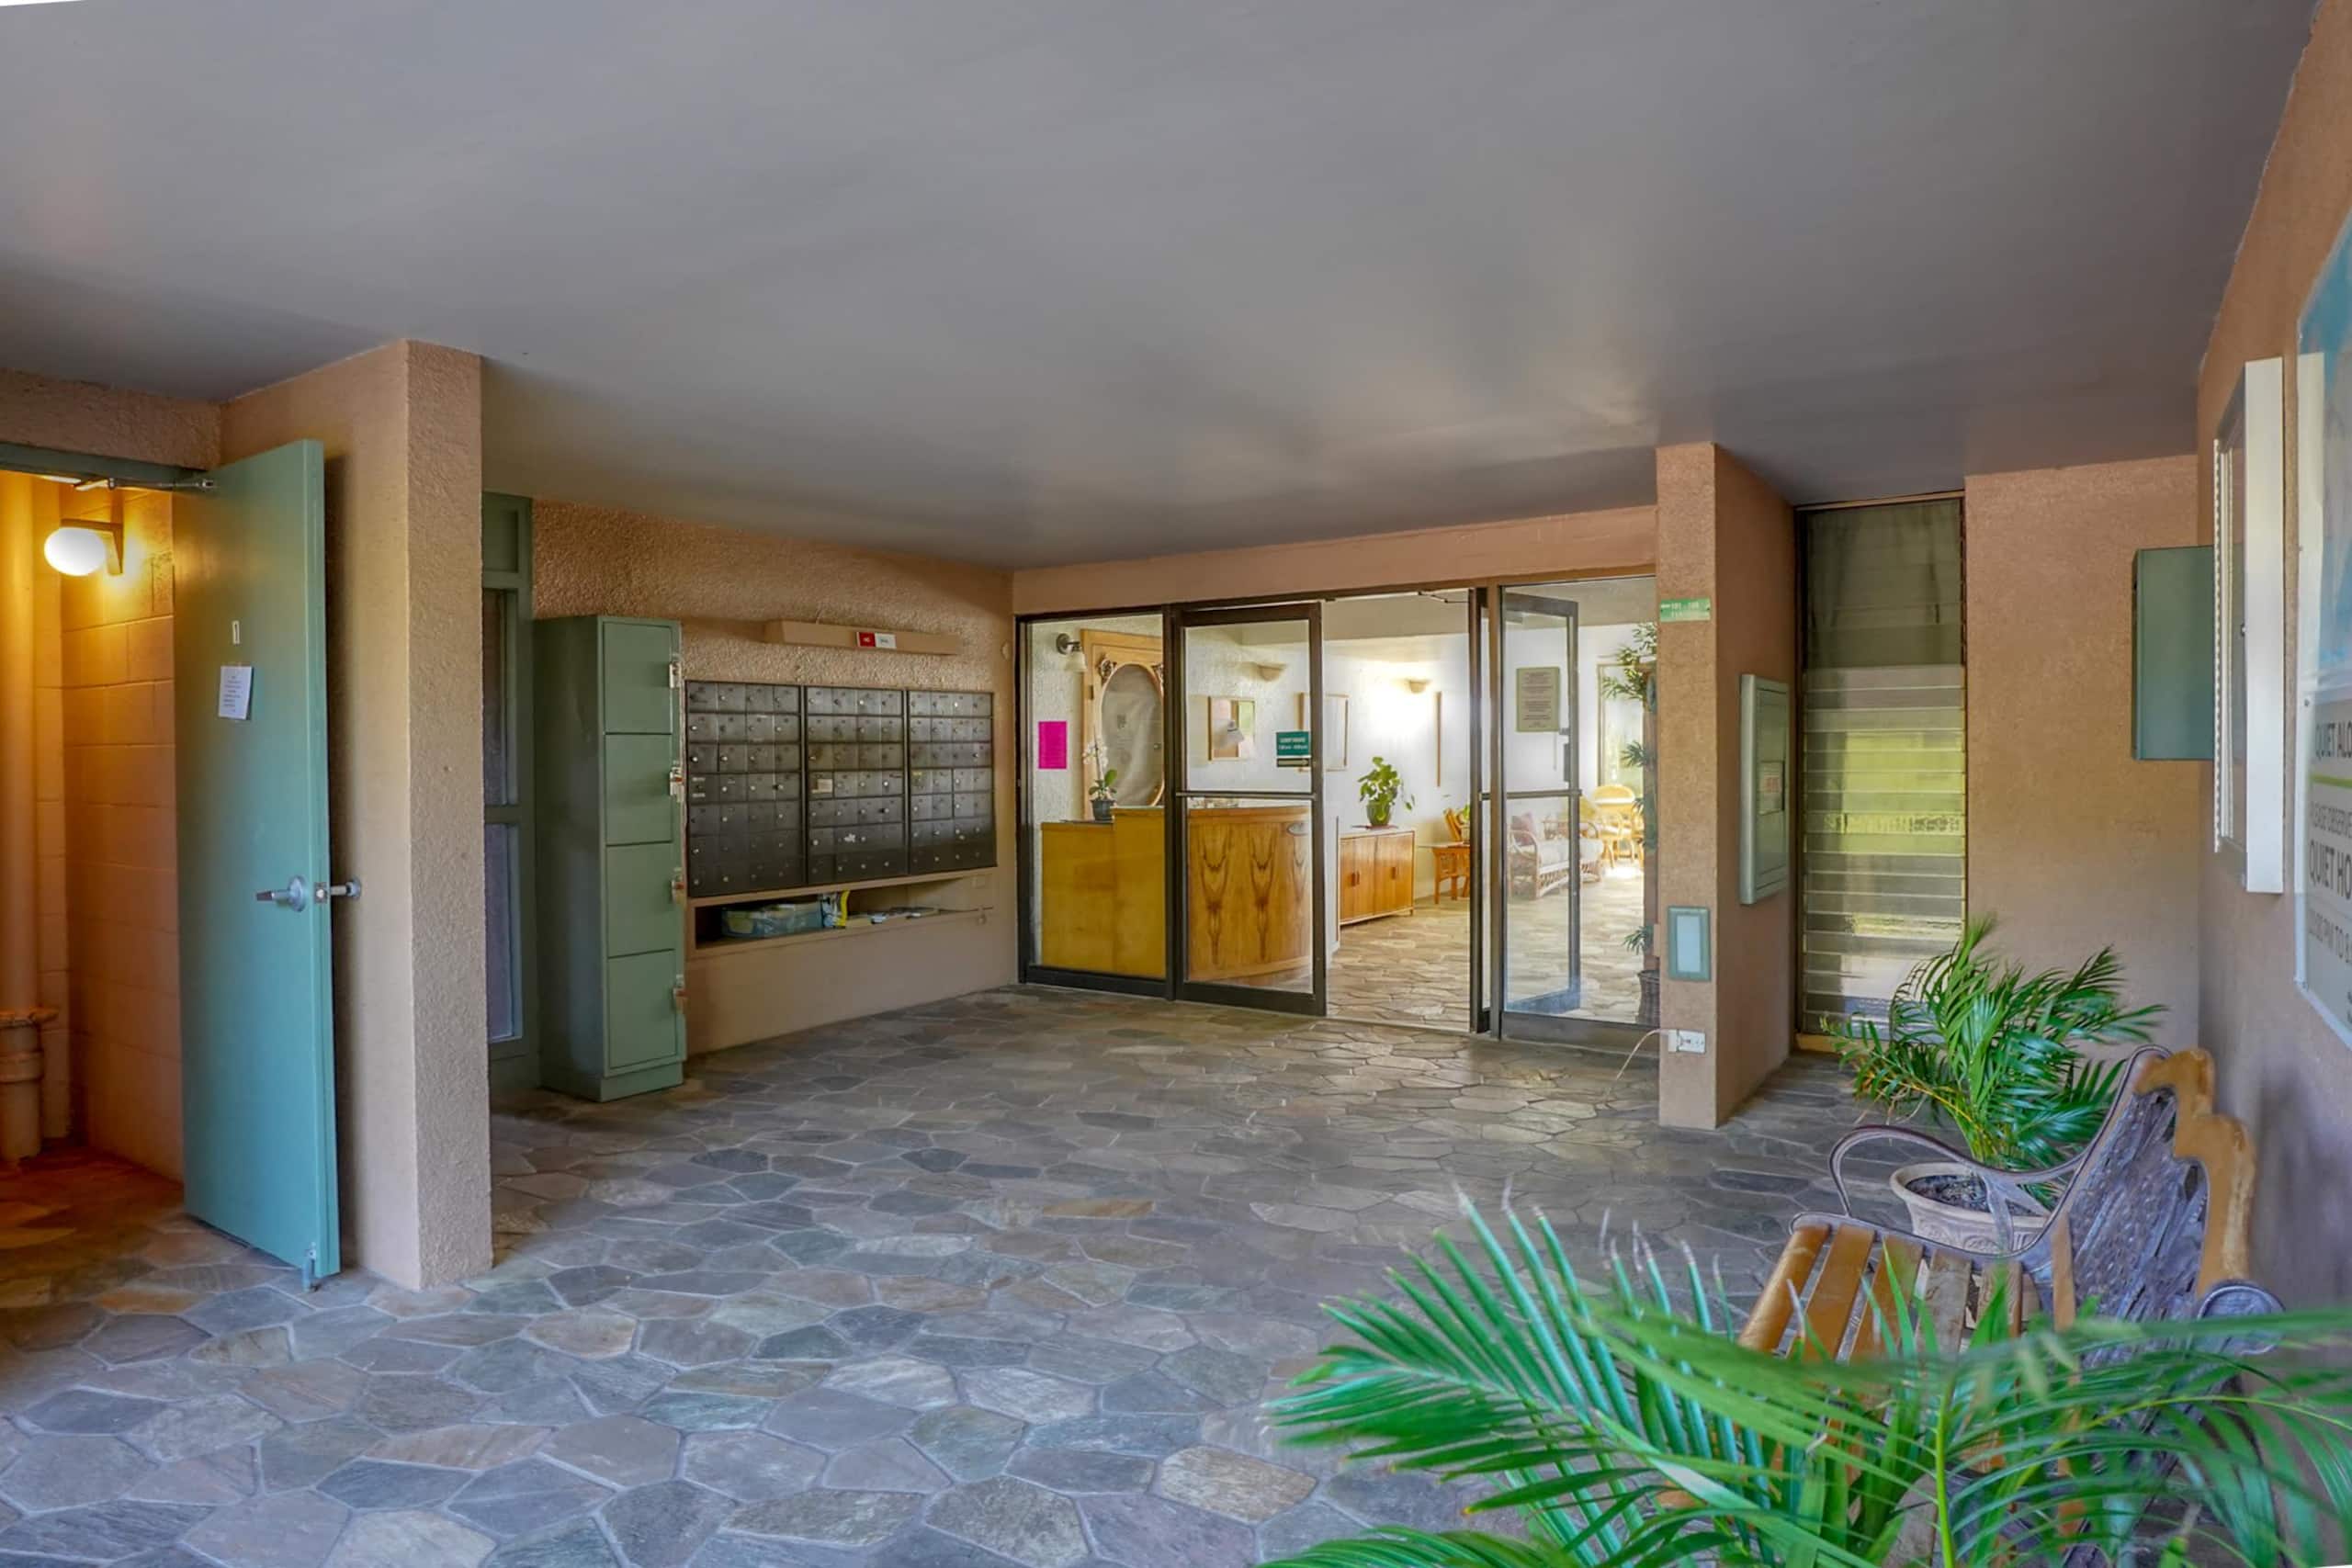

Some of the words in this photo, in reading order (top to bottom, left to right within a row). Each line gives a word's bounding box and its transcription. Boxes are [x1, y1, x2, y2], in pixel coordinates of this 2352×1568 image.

[2315, 722, 2335, 761] QUIET
[2309, 839, 2335, 890] QUIET
[2336, 850, 2352, 900] HO
